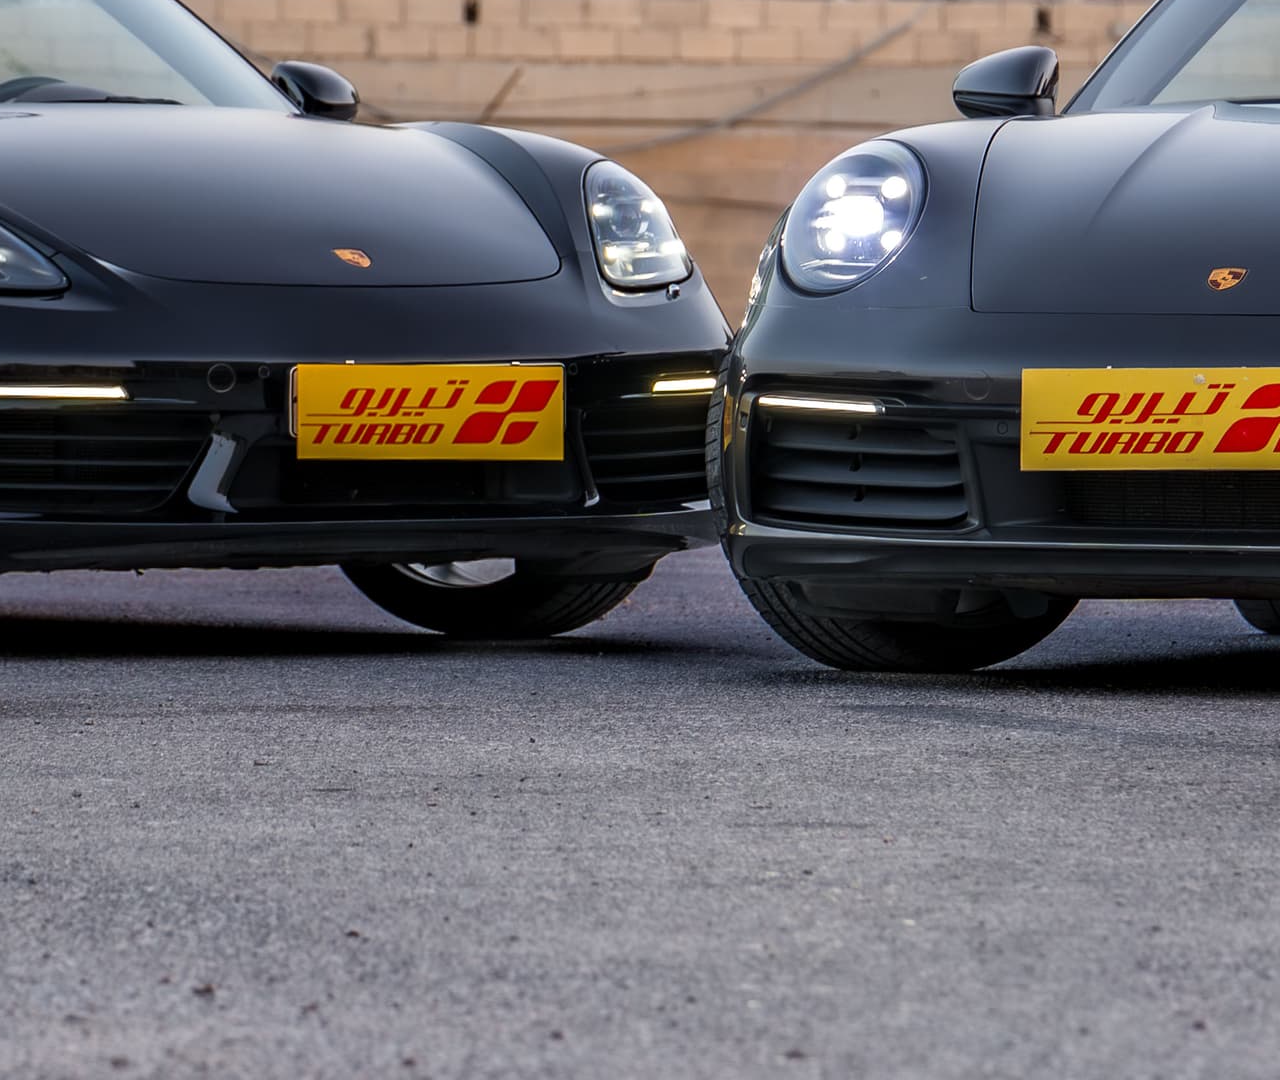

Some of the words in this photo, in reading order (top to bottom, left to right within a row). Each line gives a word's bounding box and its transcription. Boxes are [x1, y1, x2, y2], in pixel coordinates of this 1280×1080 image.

[305, 379, 470, 418] تيربو
[1036, 383, 1236, 425] تيربو
[300, 423, 445, 445] TURBO
[1029, 431, 1205, 455] TURBO
